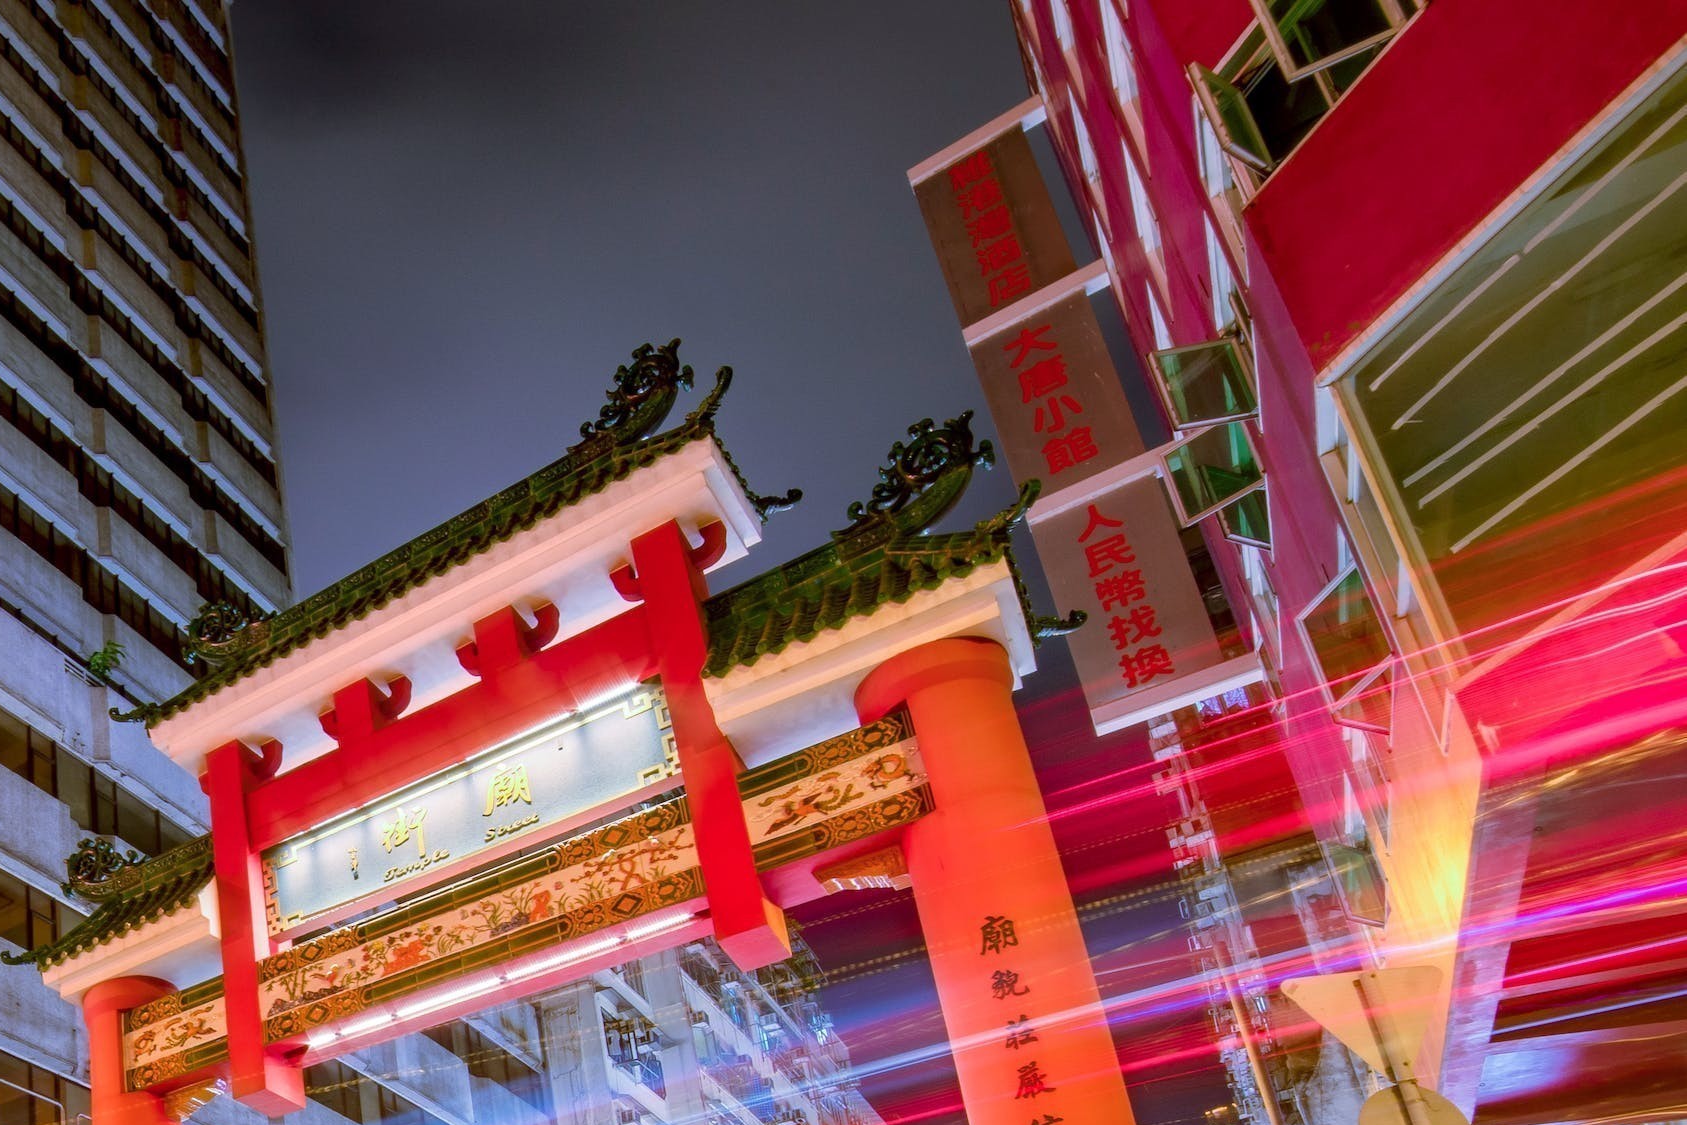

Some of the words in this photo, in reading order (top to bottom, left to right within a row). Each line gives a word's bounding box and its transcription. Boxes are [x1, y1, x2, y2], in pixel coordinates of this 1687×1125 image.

[1003, 323, 1099, 475] 大唐小館
[1077, 503, 1175, 689] 人民幣找換
[383, 849, 450, 882] Temple
[484, 812, 540, 843] Street
